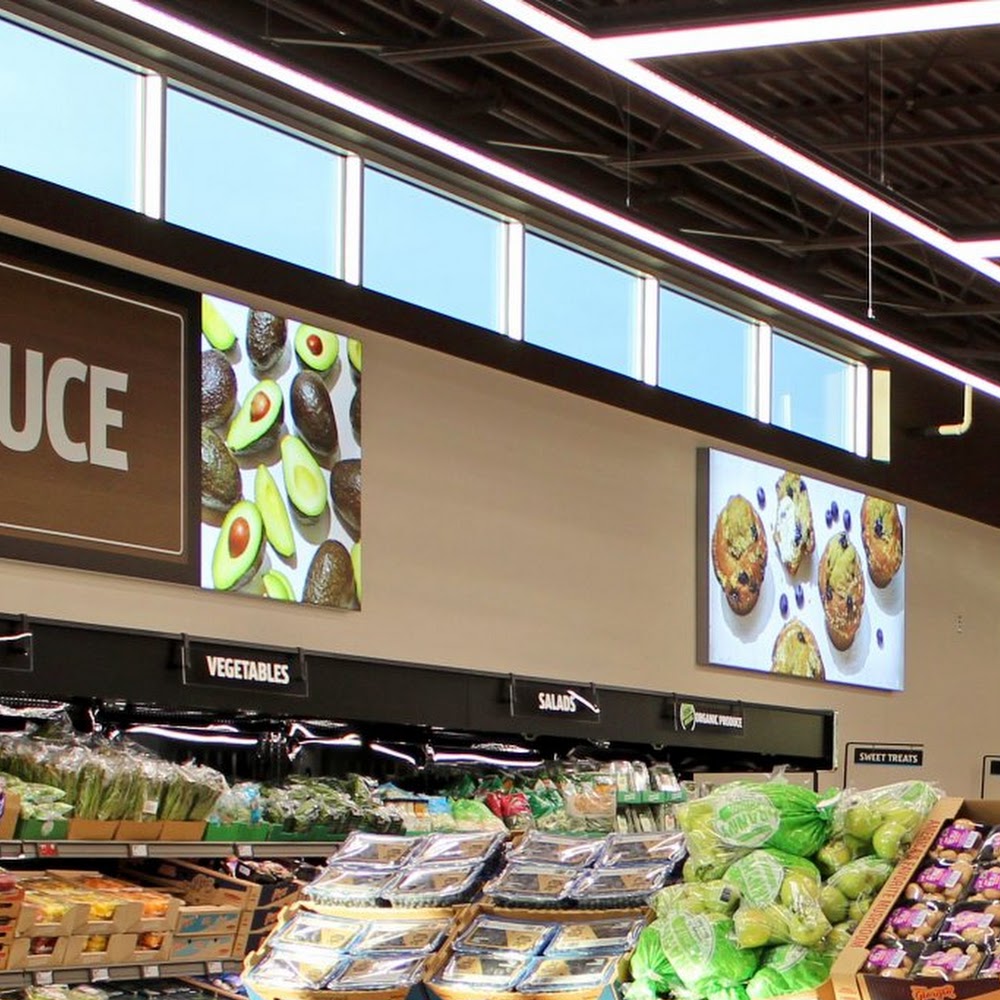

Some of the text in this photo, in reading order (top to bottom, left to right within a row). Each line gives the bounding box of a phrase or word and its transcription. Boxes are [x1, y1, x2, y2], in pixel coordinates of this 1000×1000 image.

[0, 342, 128, 471] UCE
[206, 655, 290, 685] VEGETABLES
[538, 692, 576, 713] SALADS
[859, 752, 918, 763] SWEET TREATS
